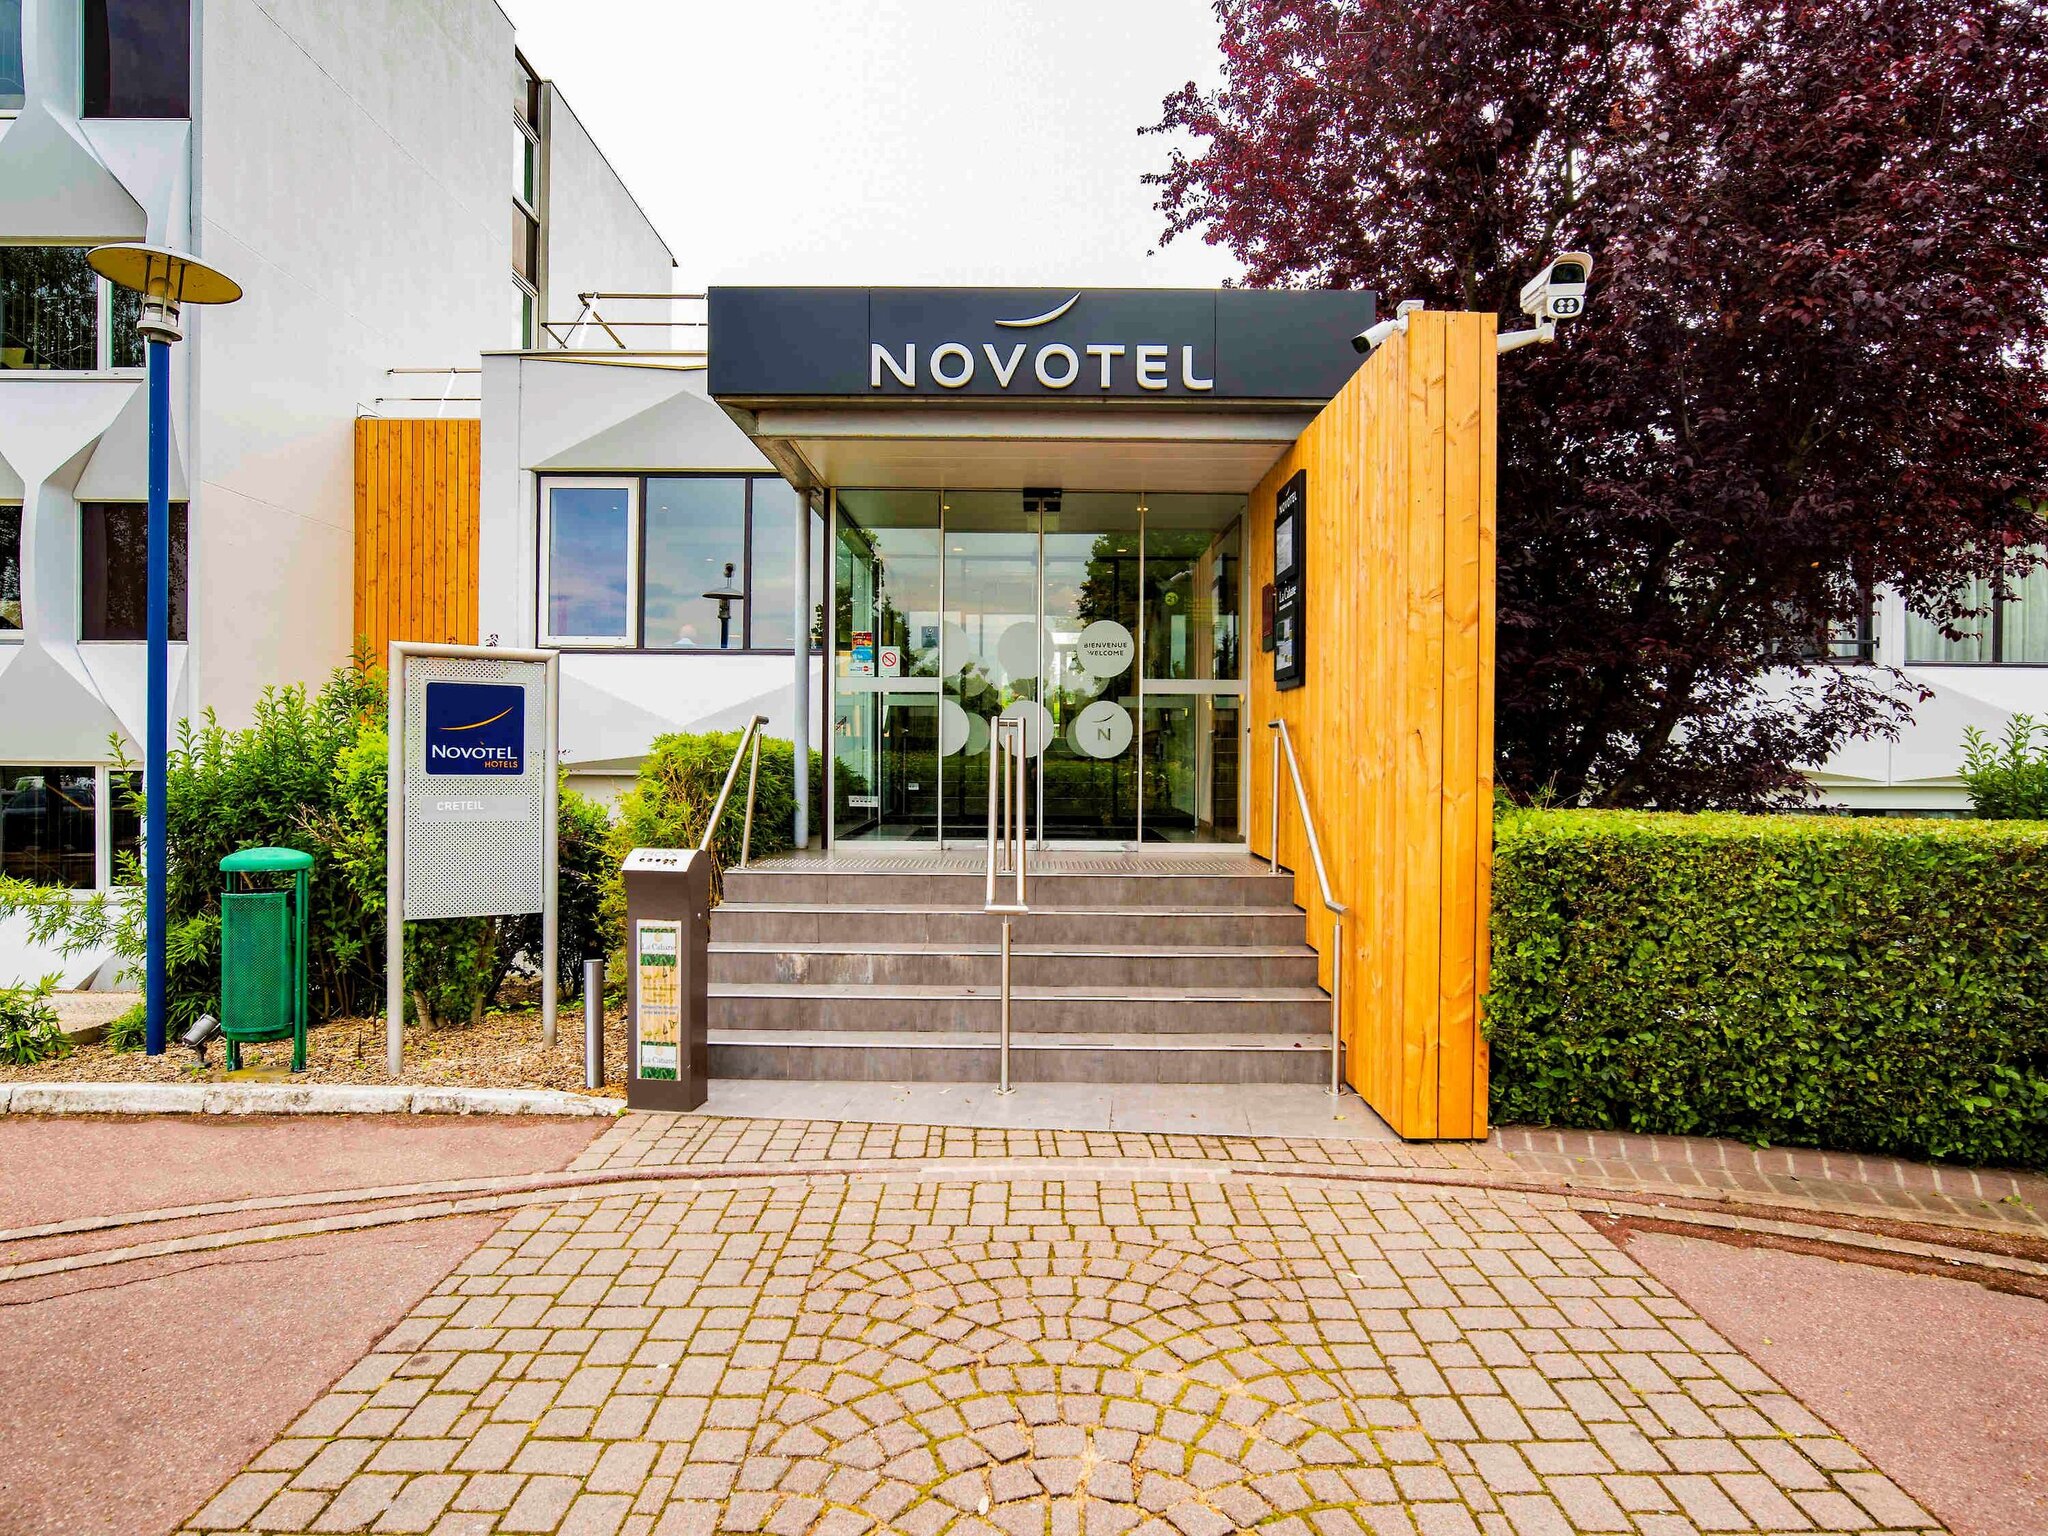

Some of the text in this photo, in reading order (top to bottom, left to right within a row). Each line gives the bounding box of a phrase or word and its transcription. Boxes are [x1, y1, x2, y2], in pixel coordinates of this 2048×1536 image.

[870, 342, 1214, 390] NOVOTEL
[1083, 641, 1128, 649] BIENVENUE
[1087, 649, 1124, 657] WELCOME
[1097, 727, 1111, 741] N
[432, 744, 518, 760] NOVOTEL
[484, 760, 519, 769] HOTELS
[436, 800, 485, 811] CRETEIL
